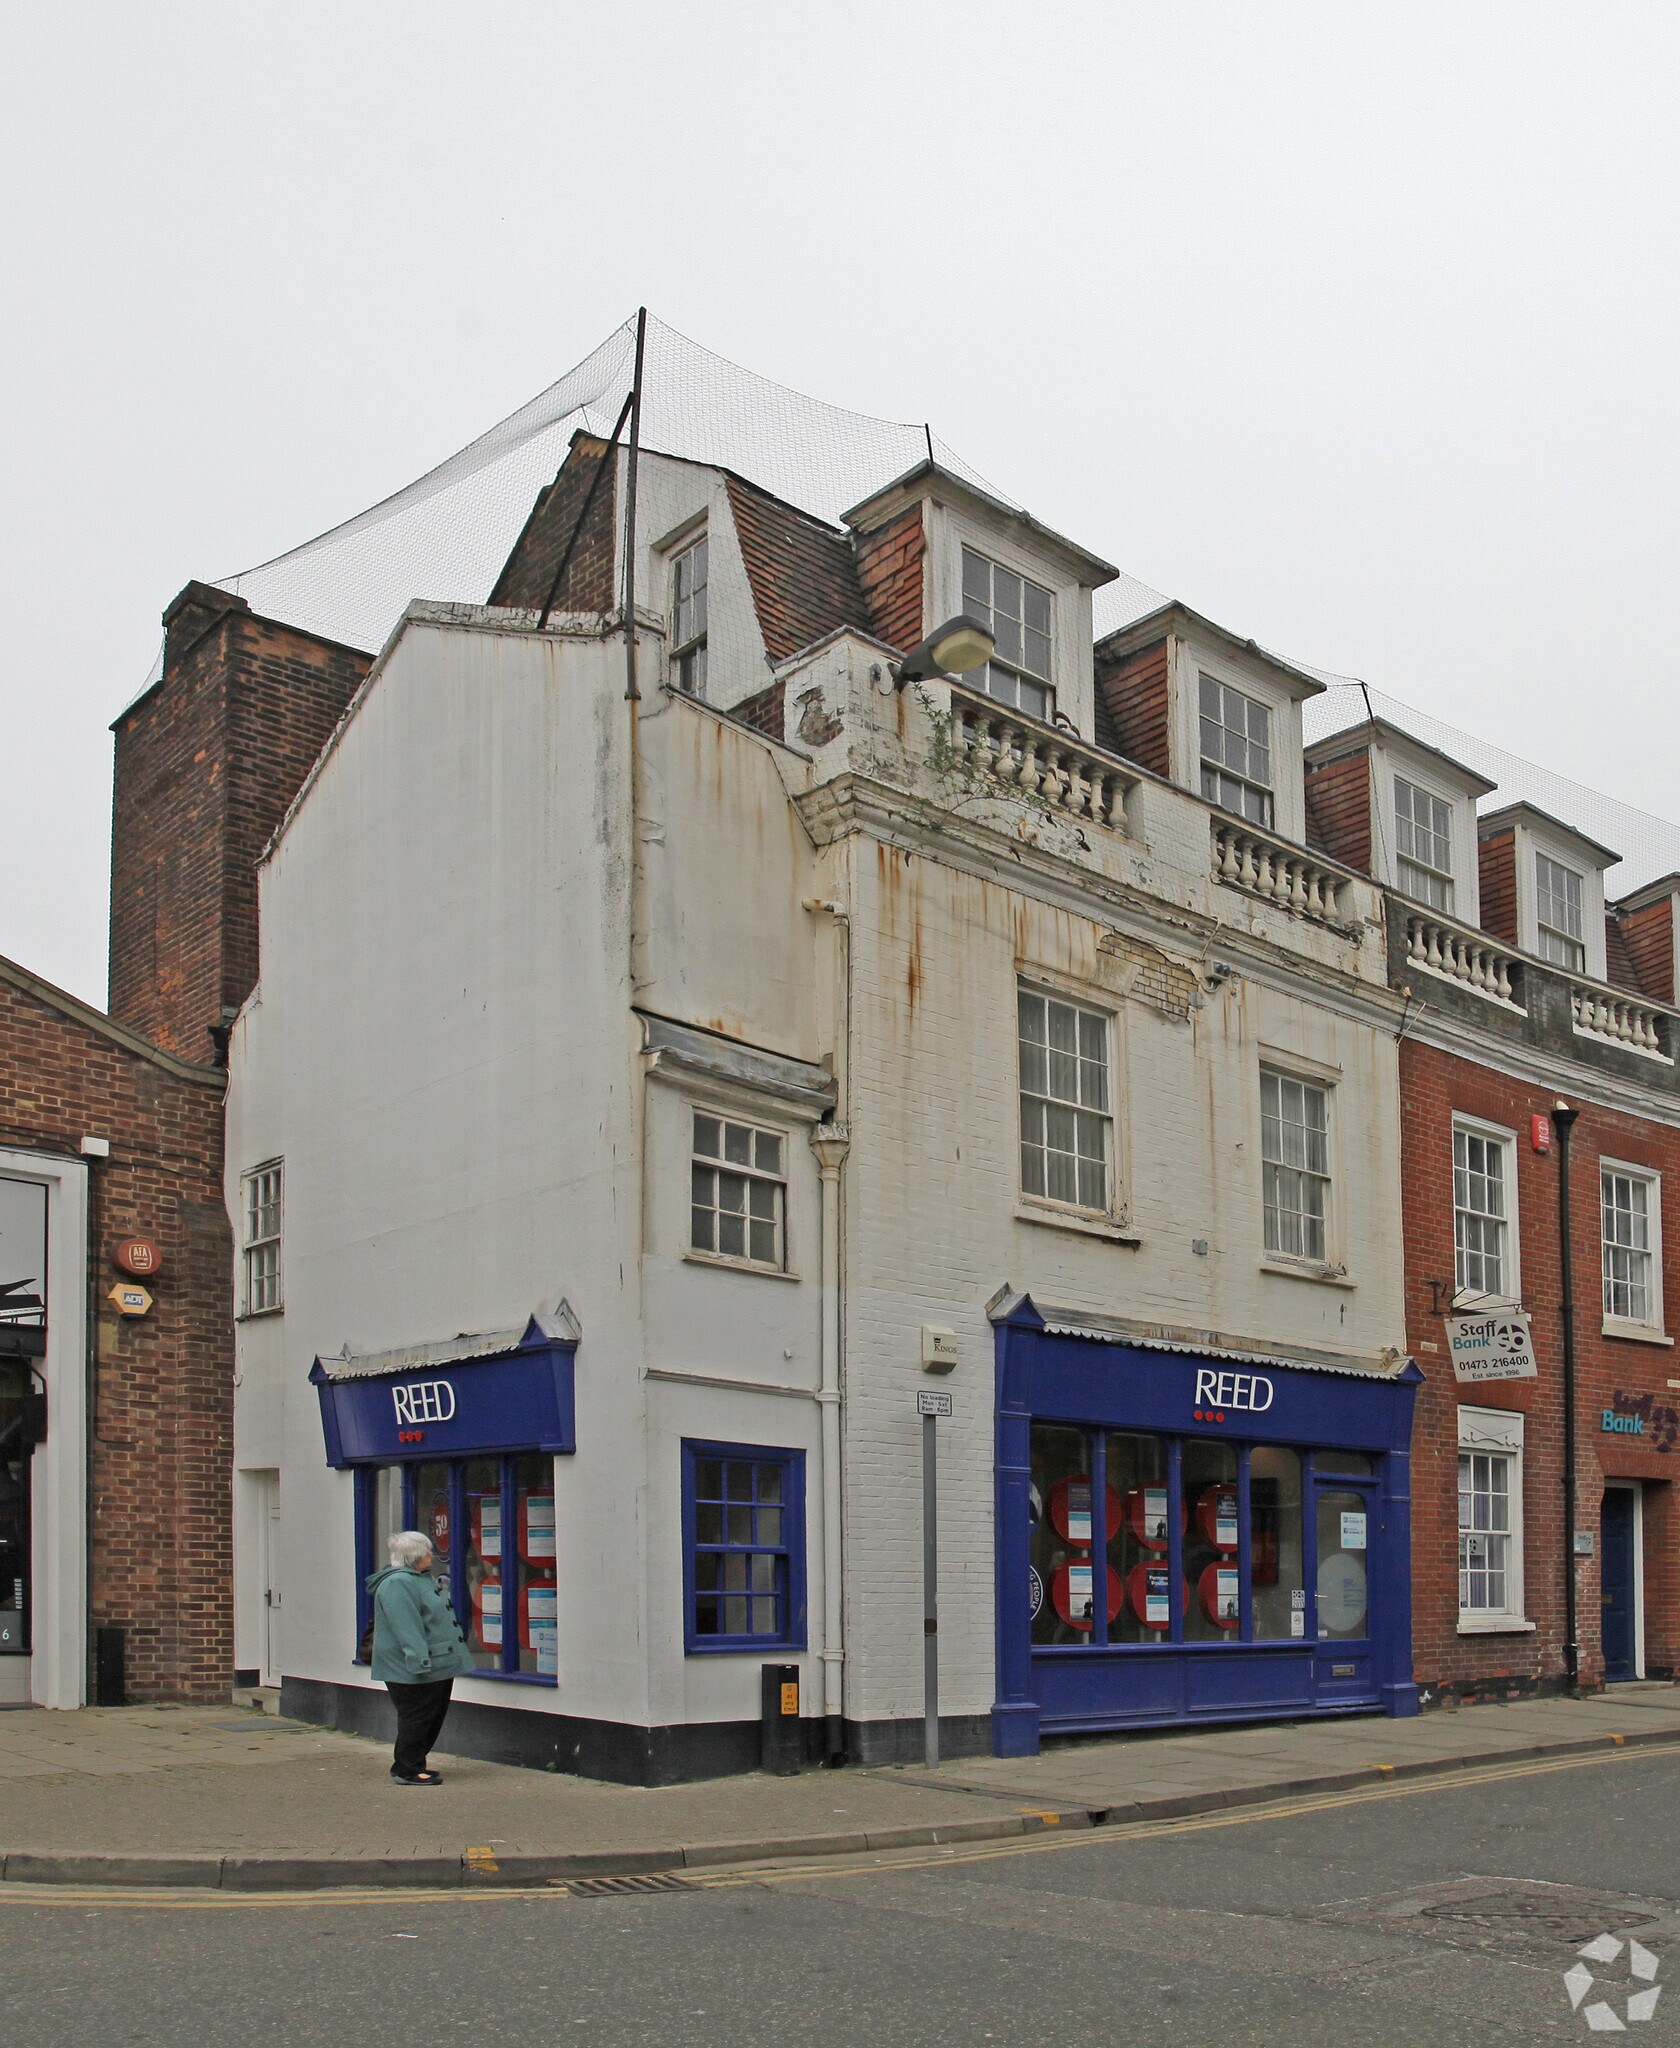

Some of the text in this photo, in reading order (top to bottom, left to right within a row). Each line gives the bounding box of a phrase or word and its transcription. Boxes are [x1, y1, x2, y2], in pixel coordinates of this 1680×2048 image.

[133, 1247, 148, 1257] AFA
[124, 1295, 143, 1304] ADT
[1460, 1320, 1497, 1337] Staff
[1453, 1335, 1491, 1350] Bank
[1459, 1355, 1529, 1371] 01473 216400
[1485, 1370, 1503, 1378] since
[1195, 1369, 1274, 1411] REED
[392, 1380, 456, 1425] REED
[1602, 1409, 1645, 1434] Bank
[435, 1514, 448, 1537] 50
[1030, 1581, 1039, 1610] PEOPLE
[2, 1629, 10, 1640] 6
